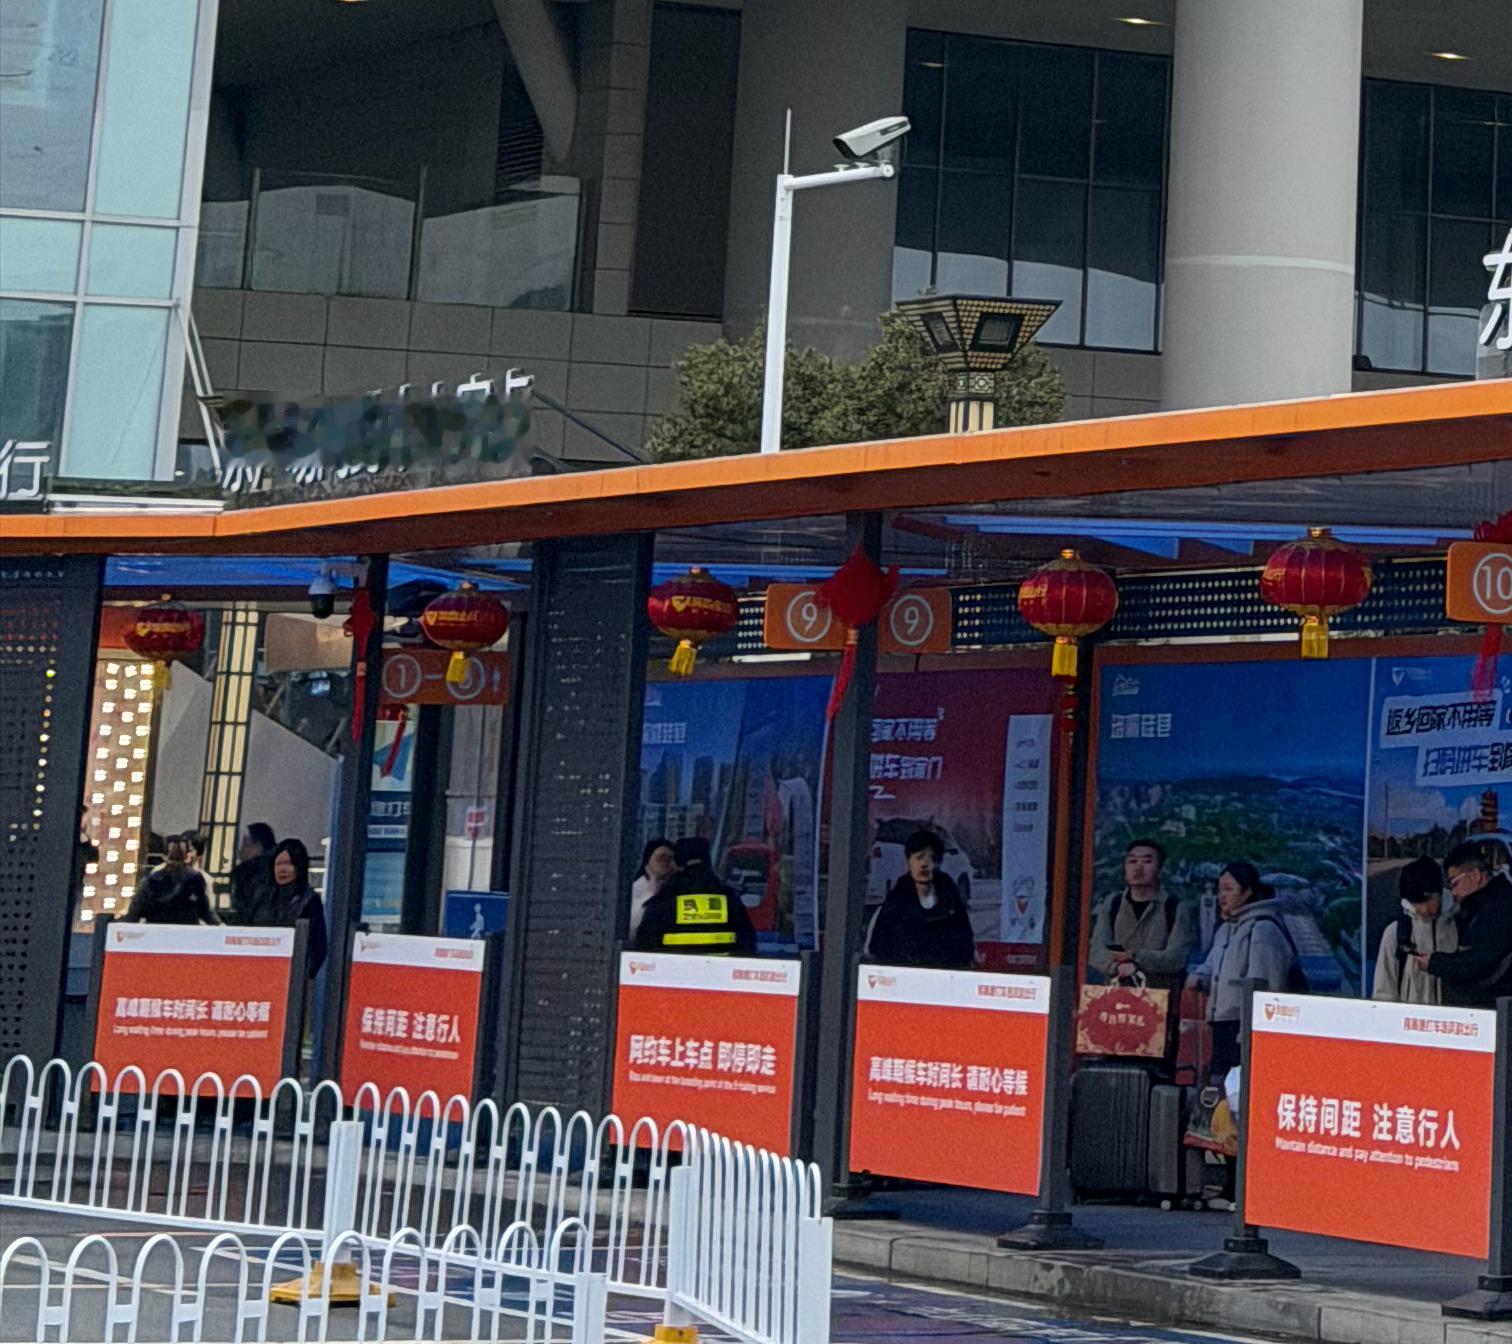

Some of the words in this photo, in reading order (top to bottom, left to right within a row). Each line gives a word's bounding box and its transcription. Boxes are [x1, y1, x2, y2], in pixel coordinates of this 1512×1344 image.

[1277, 1093, 1362, 1139] 保持间距
[1373, 1103, 1461, 1151] 注意行人
